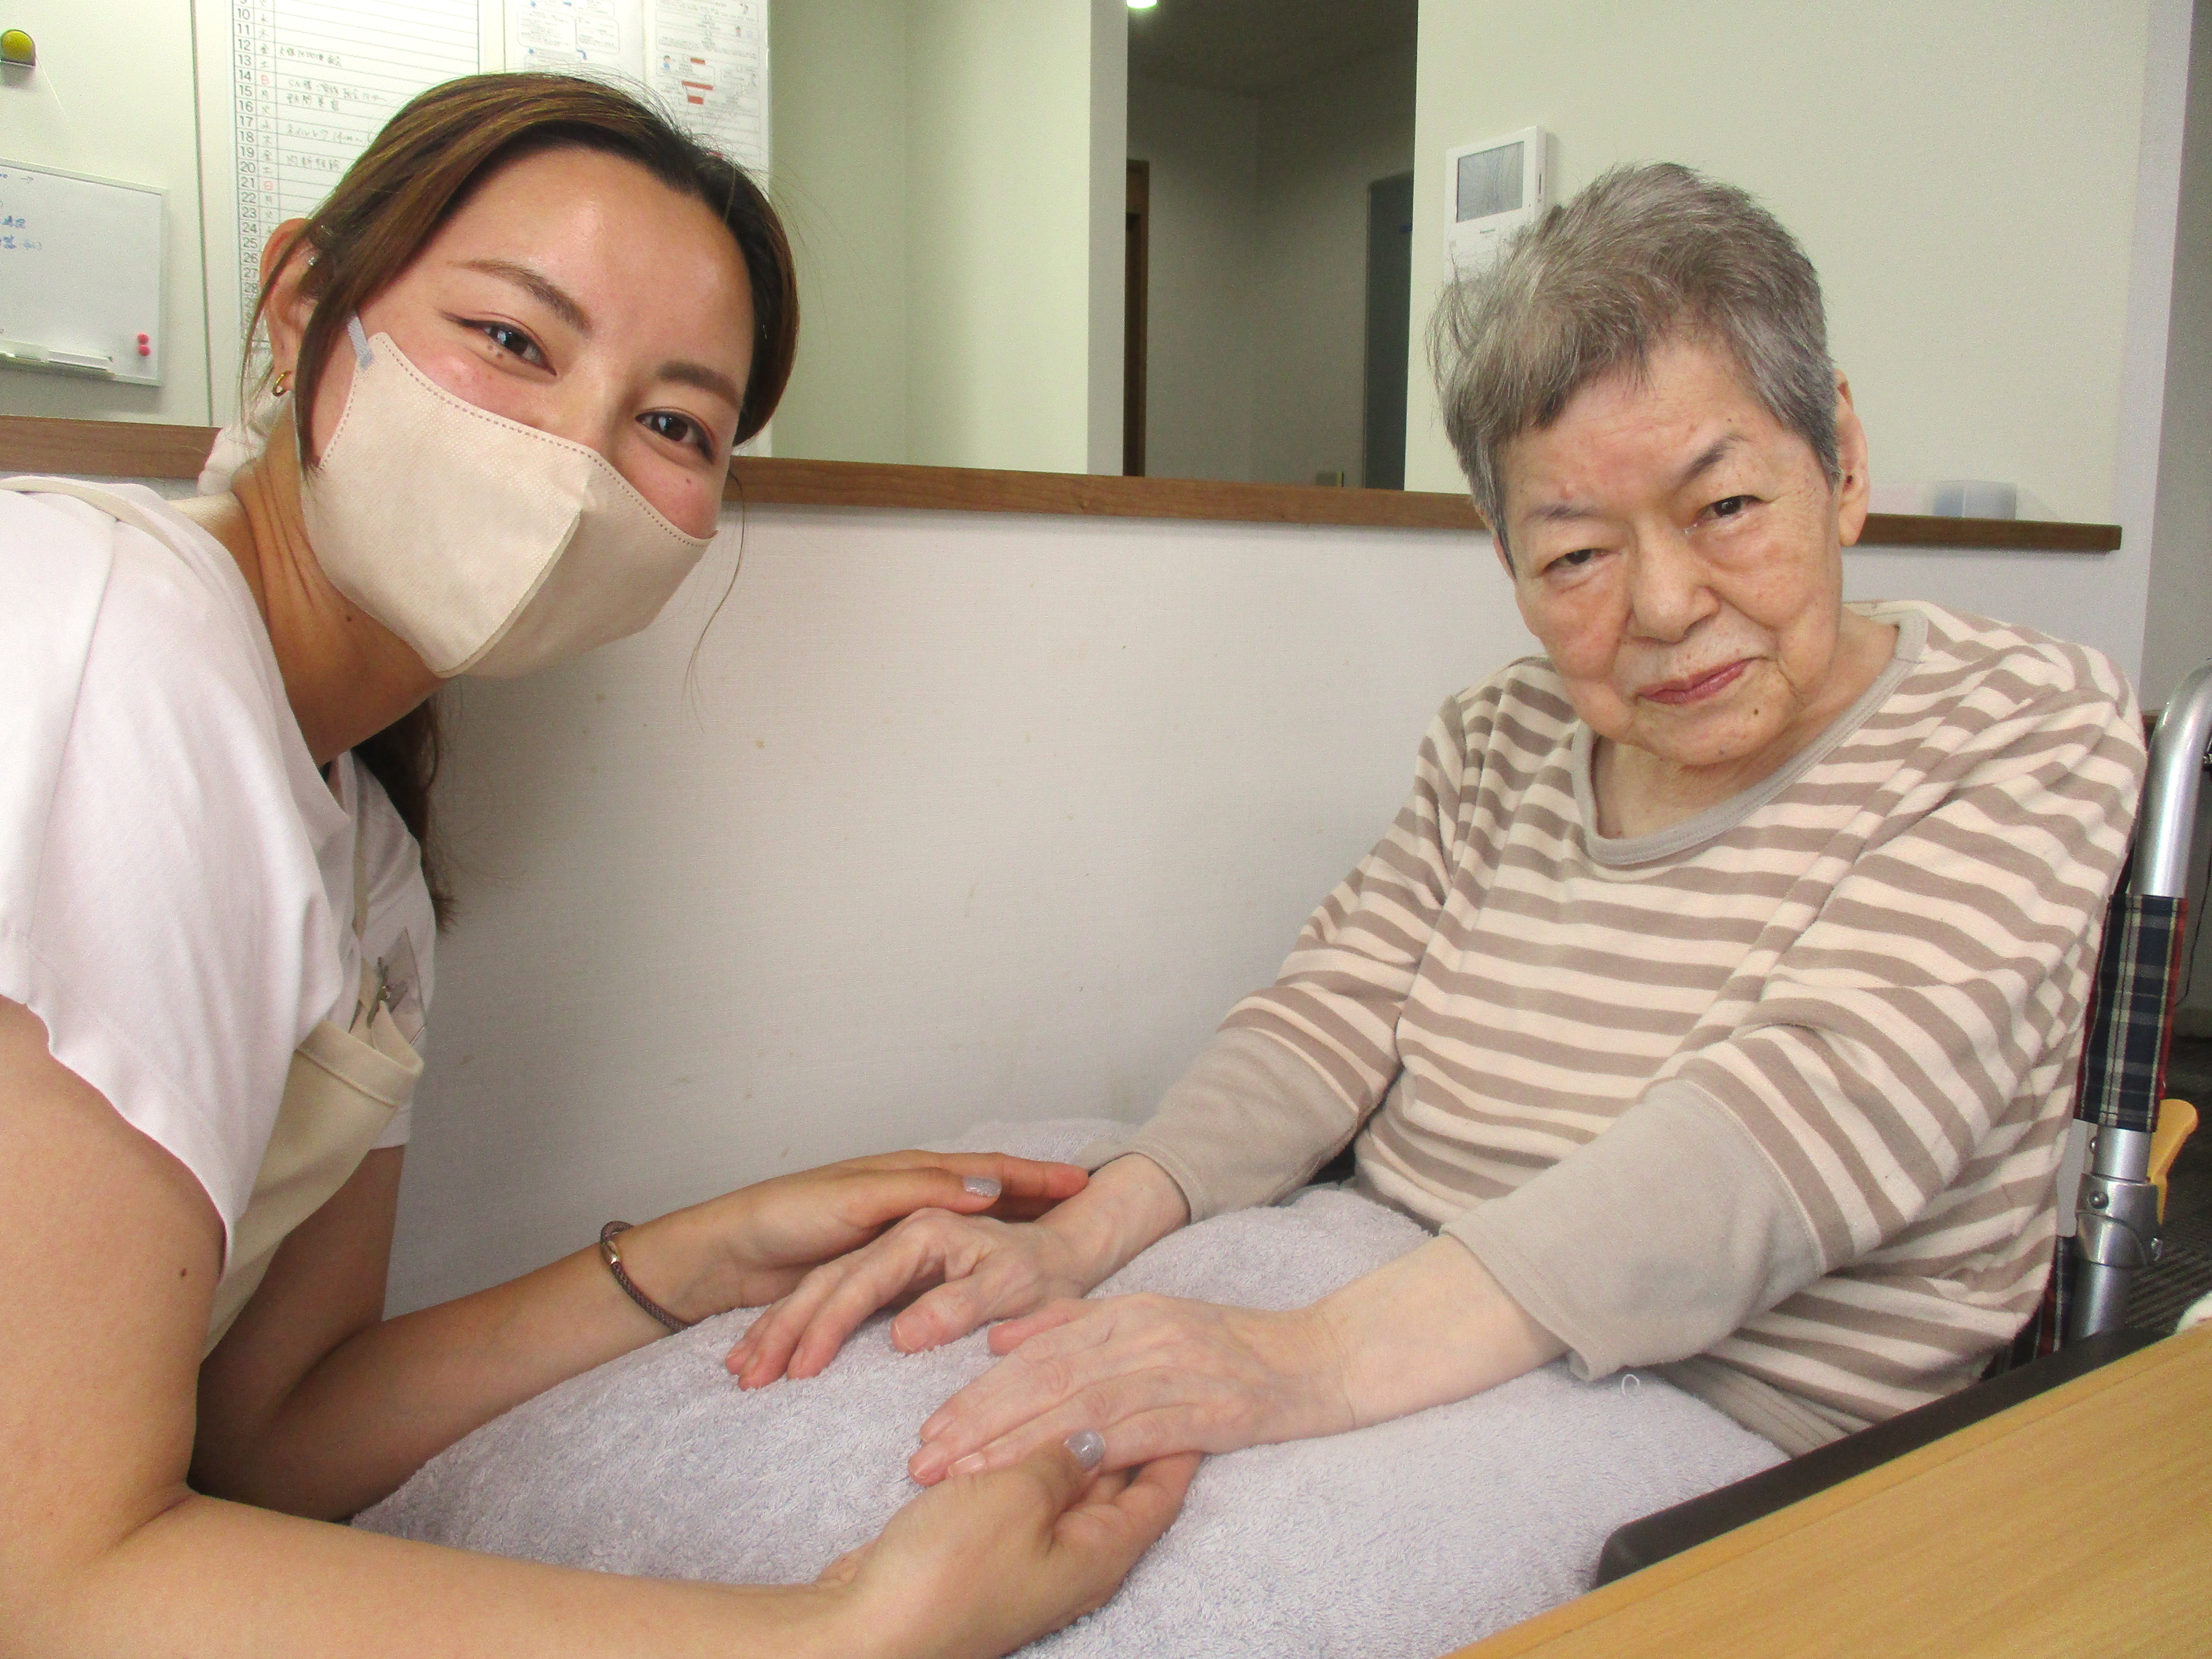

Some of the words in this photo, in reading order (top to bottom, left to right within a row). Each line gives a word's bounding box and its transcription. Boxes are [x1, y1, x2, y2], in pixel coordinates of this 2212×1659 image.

[237, 8, 250, 20] 10
[238, 23, 249, 35] 11
[238, 39, 251, 51] 12
[238, 54, 251, 67] 13
[238, 70, 252, 82] 14
[261, 75, 270, 85] 日
[239, 85, 252, 97] 15
[239, 100, 253, 112] 16
[239, 115, 253, 127] 17
[240, 131, 254, 143] 18
[240, 146, 254, 158] 19
[240, 161, 255, 173] 20
[241, 176, 254, 188] 21
[263, 181, 273, 190] 日
[242, 191, 256, 204] 22
[242, 207, 256, 219] 23
[243, 222, 257, 234] 24
[243, 237, 257, 249] 25
[243, 252, 258, 263] 26
[243, 267, 258, 277] 27
[244, 282, 257, 293] 28
